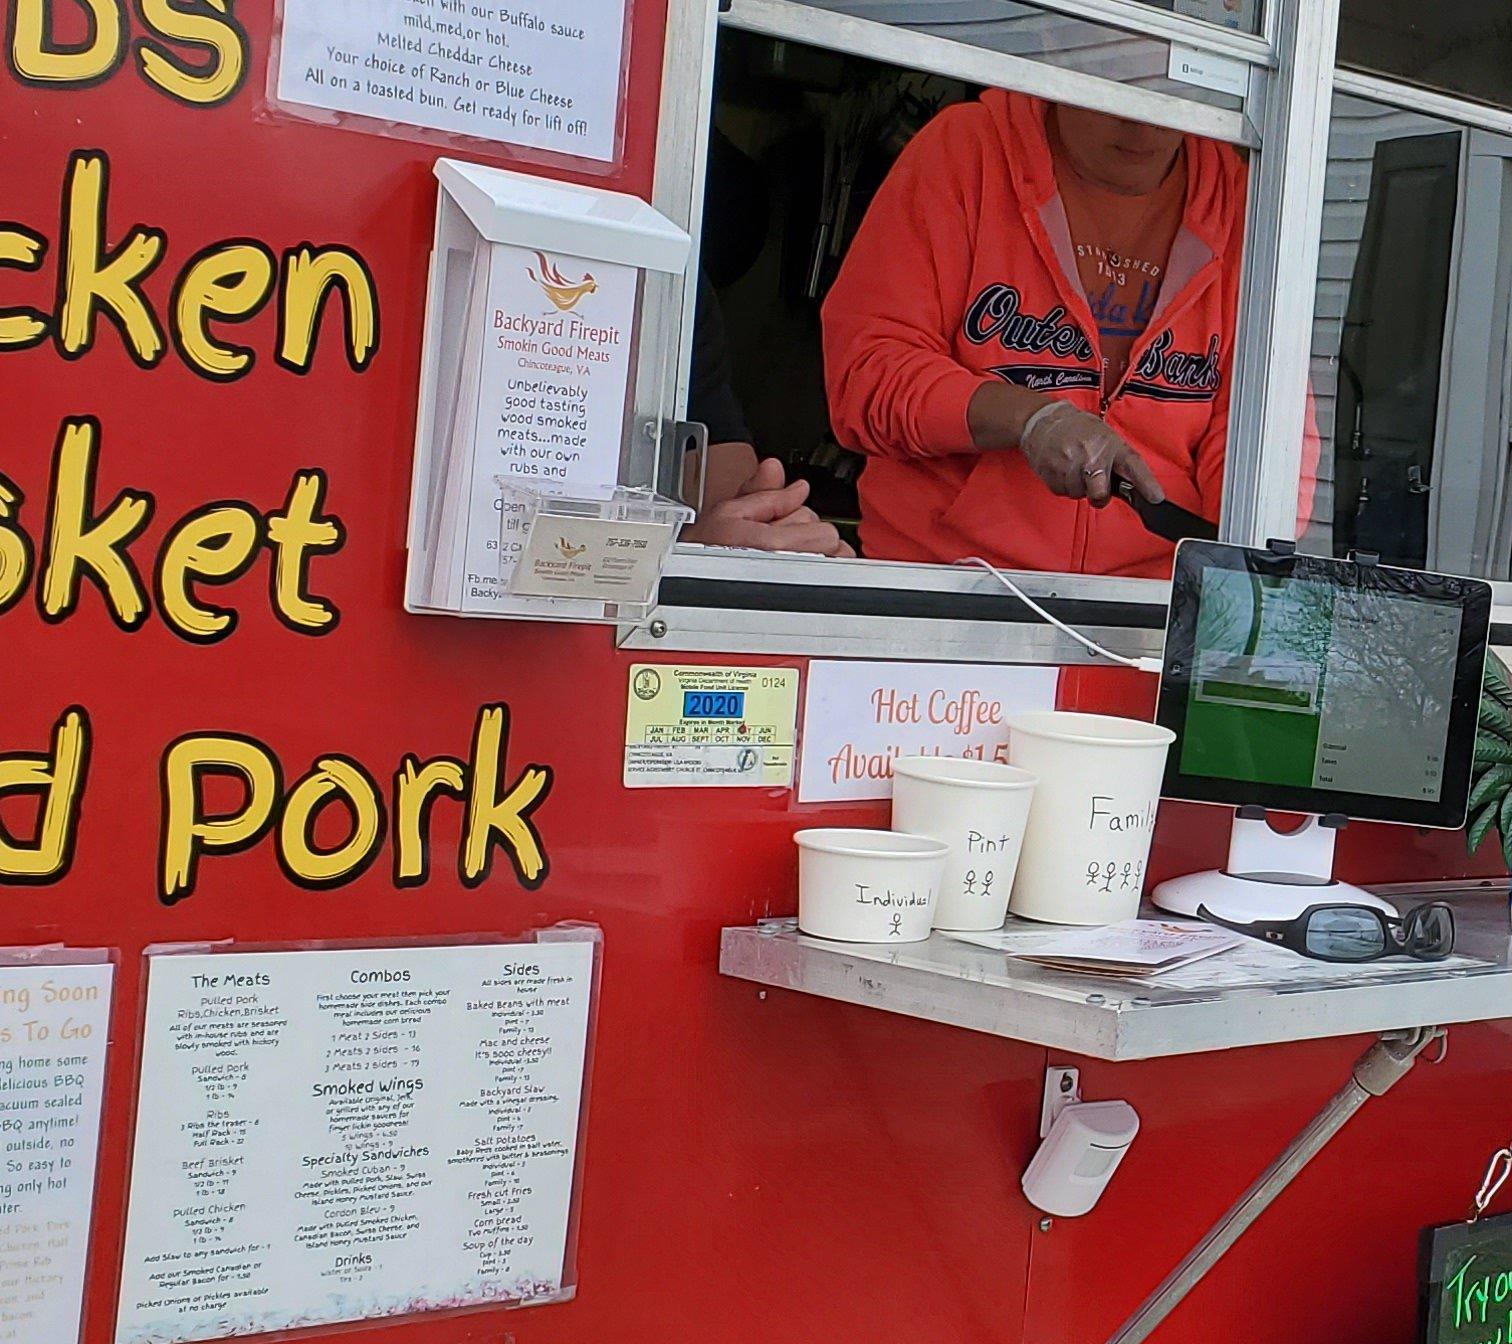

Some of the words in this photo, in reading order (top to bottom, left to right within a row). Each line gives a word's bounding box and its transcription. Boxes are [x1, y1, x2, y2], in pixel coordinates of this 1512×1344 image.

[471, 6, 494, 20] our
[499, 9, 545, 32] Buffalo
[550, 23, 586, 40] sauce
[377, 32, 422, 54] Melted
[428, 42, 483, 66] Cheddar
[488, 55, 534, 77] Cheese
[326, 46, 359, 65] Your
[364, 54, 406, 74] choice
[411, 63, 425, 81] of
[430, 67, 470, 90] Ranch
[475, 79, 490, 91] or
[495, 80, 525, 100] Blue
[530, 88, 574, 109] Cheese
[305, 67, 324, 85] All
[330, 75, 348, 89] on
[352, 80, 361, 92] a
[366, 80, 414, 103] toasted
[453, 97, 477, 115] Get
[482, 103, 517, 127] ready
[522, 109, 541, 128] for
[545, 114, 562, 132] lift
[493, 309, 564, 338] Backyard
[569, 320, 620, 346] Firepit
[497, 336, 538, 355] Smokin
[541, 342, 573, 358] Good
[577, 346, 611, 363] Meats
[1135, 327, 1222, 390] Bank
[576, 366, 592, 376] VA
[508, 378, 589, 401] Unbelievably
[505, 396, 537, 412] good
[540, 397, 587, 418] tasting
[501, 411, 533, 425] wood
[537, 414, 588, 432] smoked
[497, 426, 587, 449] meats...made
[501, 442, 526, 457] with
[530, 448, 553, 462] our
[555, 449, 581, 462] own
[510, 461, 539, 475] rubs
[543, 463, 567, 478] and
[761, 677, 786, 688] 0124
[689, 694, 738, 716] 2020
[871, 687, 922, 725] Hot
[928, 689, 1004, 736] Coffee
[650, 726, 664, 734] JAN
[672, 726, 686, 734] FEB
[693, 726, 709, 734] MAR
[157, 704, 552, 906] Pork
[968, 830, 1011, 854] Pint
[854, 883, 933, 908] Individual
[350, 969, 411, 984] Combos
[503, 962, 540, 976] Sides
[192, 973, 219, 988] The
[223, 972, 271, 987] Meats
[41, 980, 99, 1003] Soon
[201, 996, 233, 1006] Pulled
[236, 994, 259, 1005] Pork
[22, 1020, 49, 1043] To
[60, 1017, 93, 1041] Go
[18, 1056, 51, 1069] home
[57, 1055, 88, 1067] some
[54, 1074, 85, 1089] BBQ
[312, 1078, 375, 1097] Smoked
[44, 1093, 82, 1109] sealed
[28, 1114, 79, 1133] anytime!
[6, 1137, 53, 1153] outside,
[60, 1137, 75, 1149] no
[6, 1159, 23, 1173] So
[28, 1158, 55, 1175] easy
[60, 1156, 72, 1169] to
[302, 1152, 358, 1170] Specialty
[361, 1146, 430, 1162] Sandwiches
[17, 1178, 43, 1196] only
[48, 1176, 67, 1191] hot
[335, 1253, 373, 1268] Drinks
